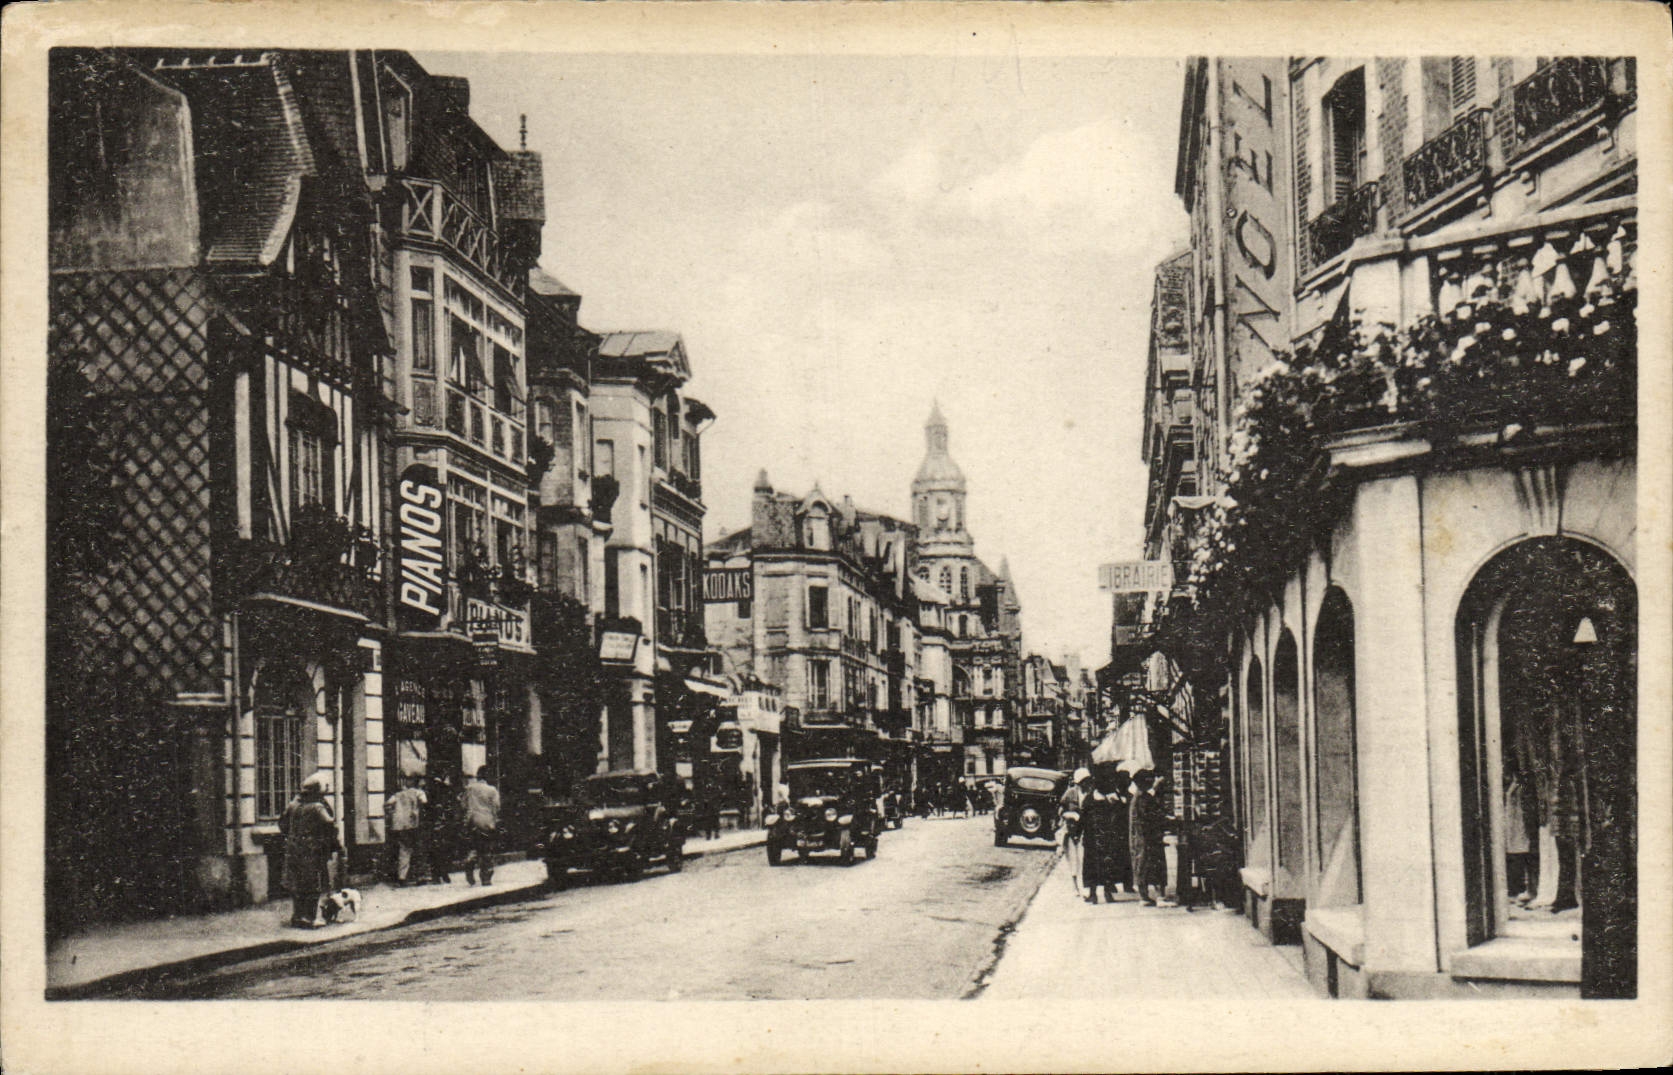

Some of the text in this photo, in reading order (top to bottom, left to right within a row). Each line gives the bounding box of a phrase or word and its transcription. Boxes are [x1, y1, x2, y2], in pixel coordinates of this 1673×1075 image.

[400, 480, 442, 615] PIANOS
[702, 572, 750, 599] KODAKS
[1099, 565, 1169, 589] LIBRAIRIE
